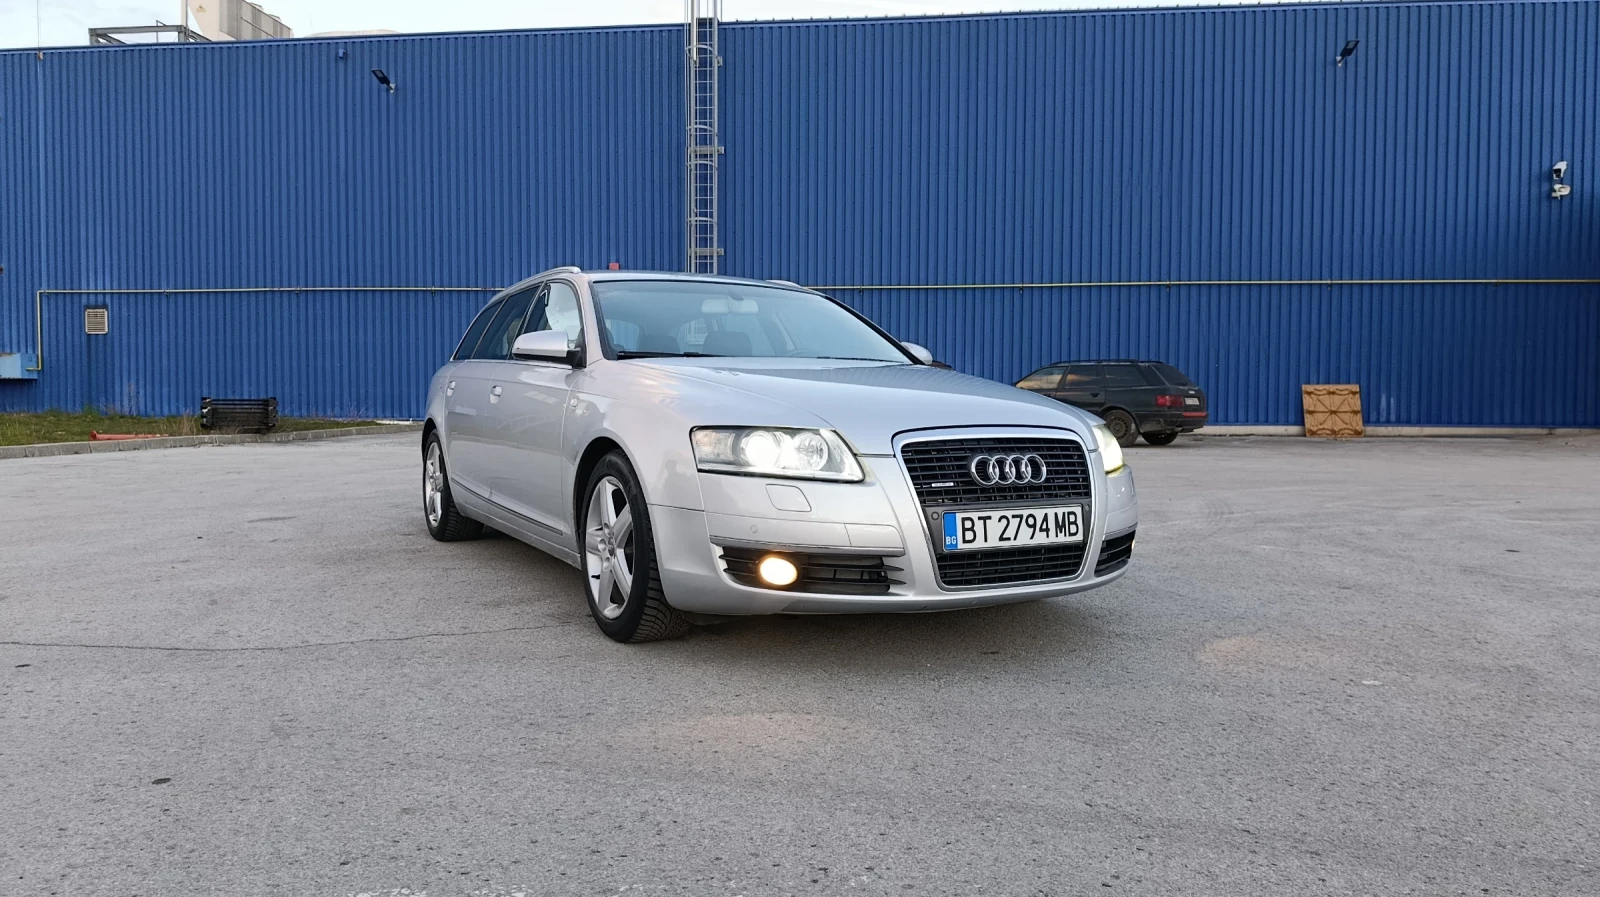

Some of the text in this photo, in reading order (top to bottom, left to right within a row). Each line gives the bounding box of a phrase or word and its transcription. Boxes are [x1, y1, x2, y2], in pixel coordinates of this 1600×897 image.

[961, 510, 1080, 544] BT 2794 MB
[945, 536, 957, 545] BG
